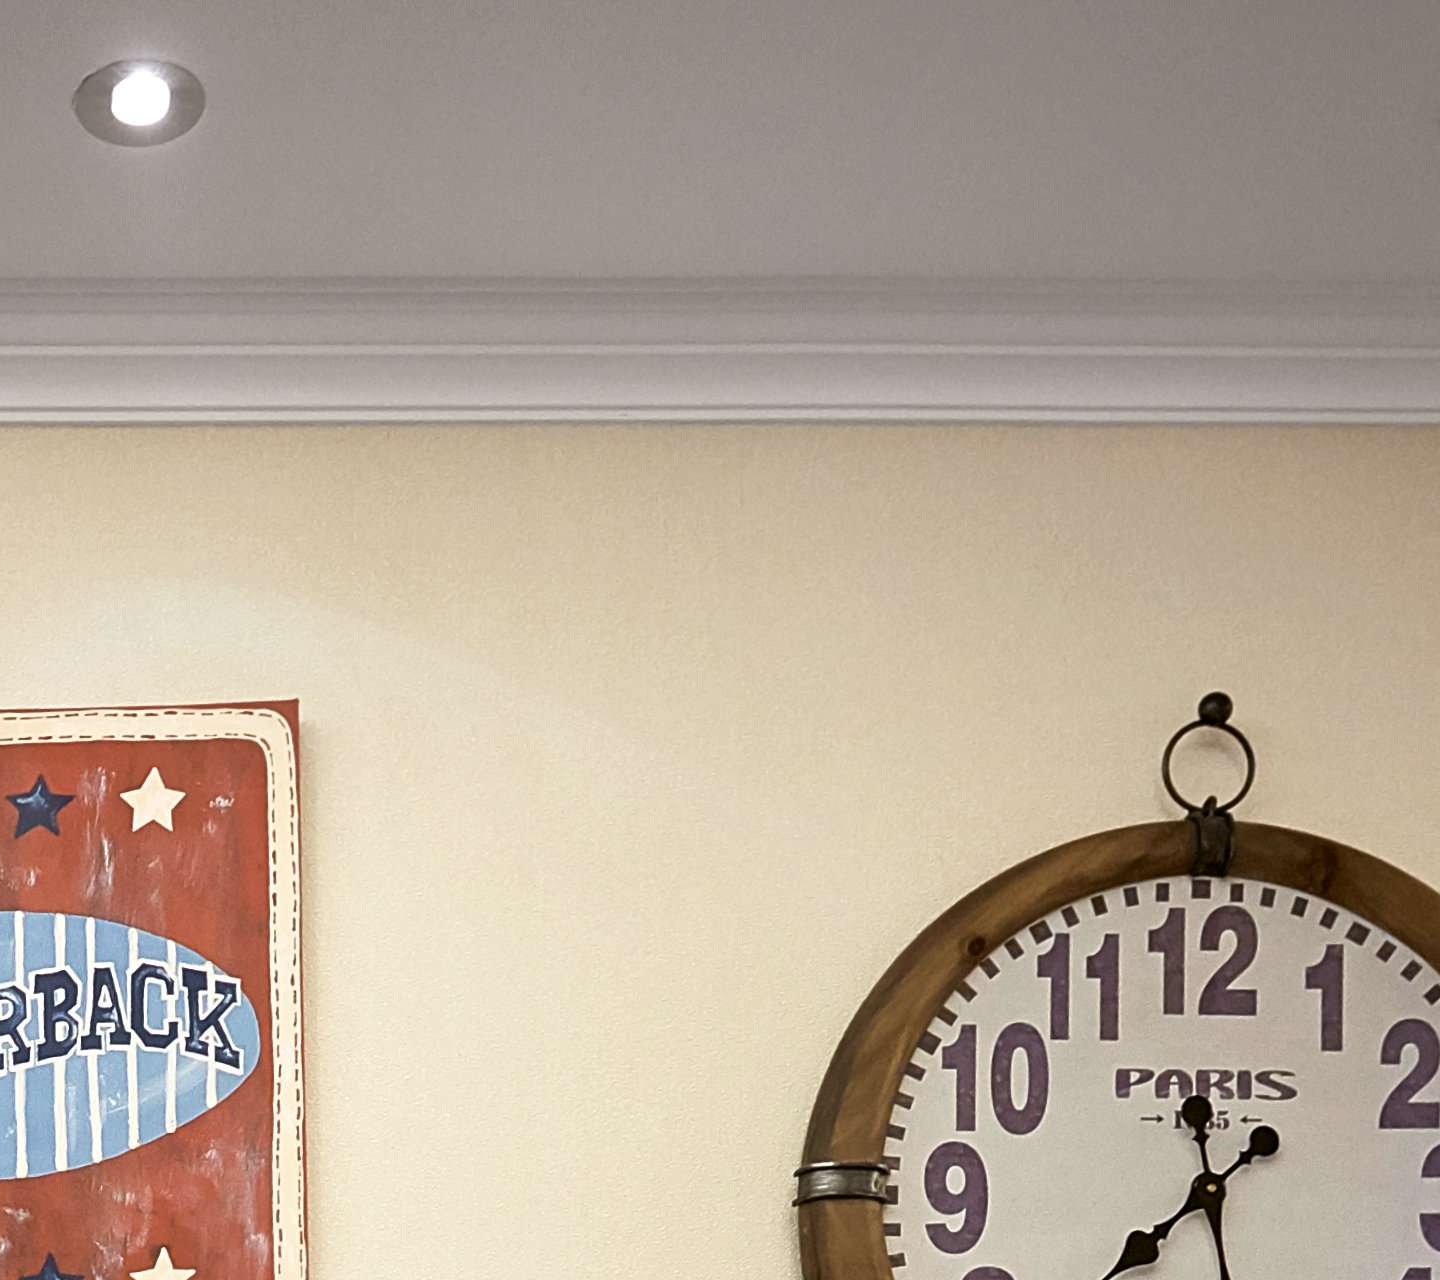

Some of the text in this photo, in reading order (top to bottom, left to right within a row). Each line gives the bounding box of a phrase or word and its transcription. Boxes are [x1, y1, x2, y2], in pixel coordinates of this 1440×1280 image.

[1037, 933, 1119, 1041] 11
[1148, 906, 1258, 1016] 12
[1305, 944, 1344, 1051] 1
[942, 1022, 1049, 1135] 10
[1115, 1068, 1298, 1100] PARIS
[1379, 1019, 1440, 1129] 2
[924, 1142, 988, 1254] 9
